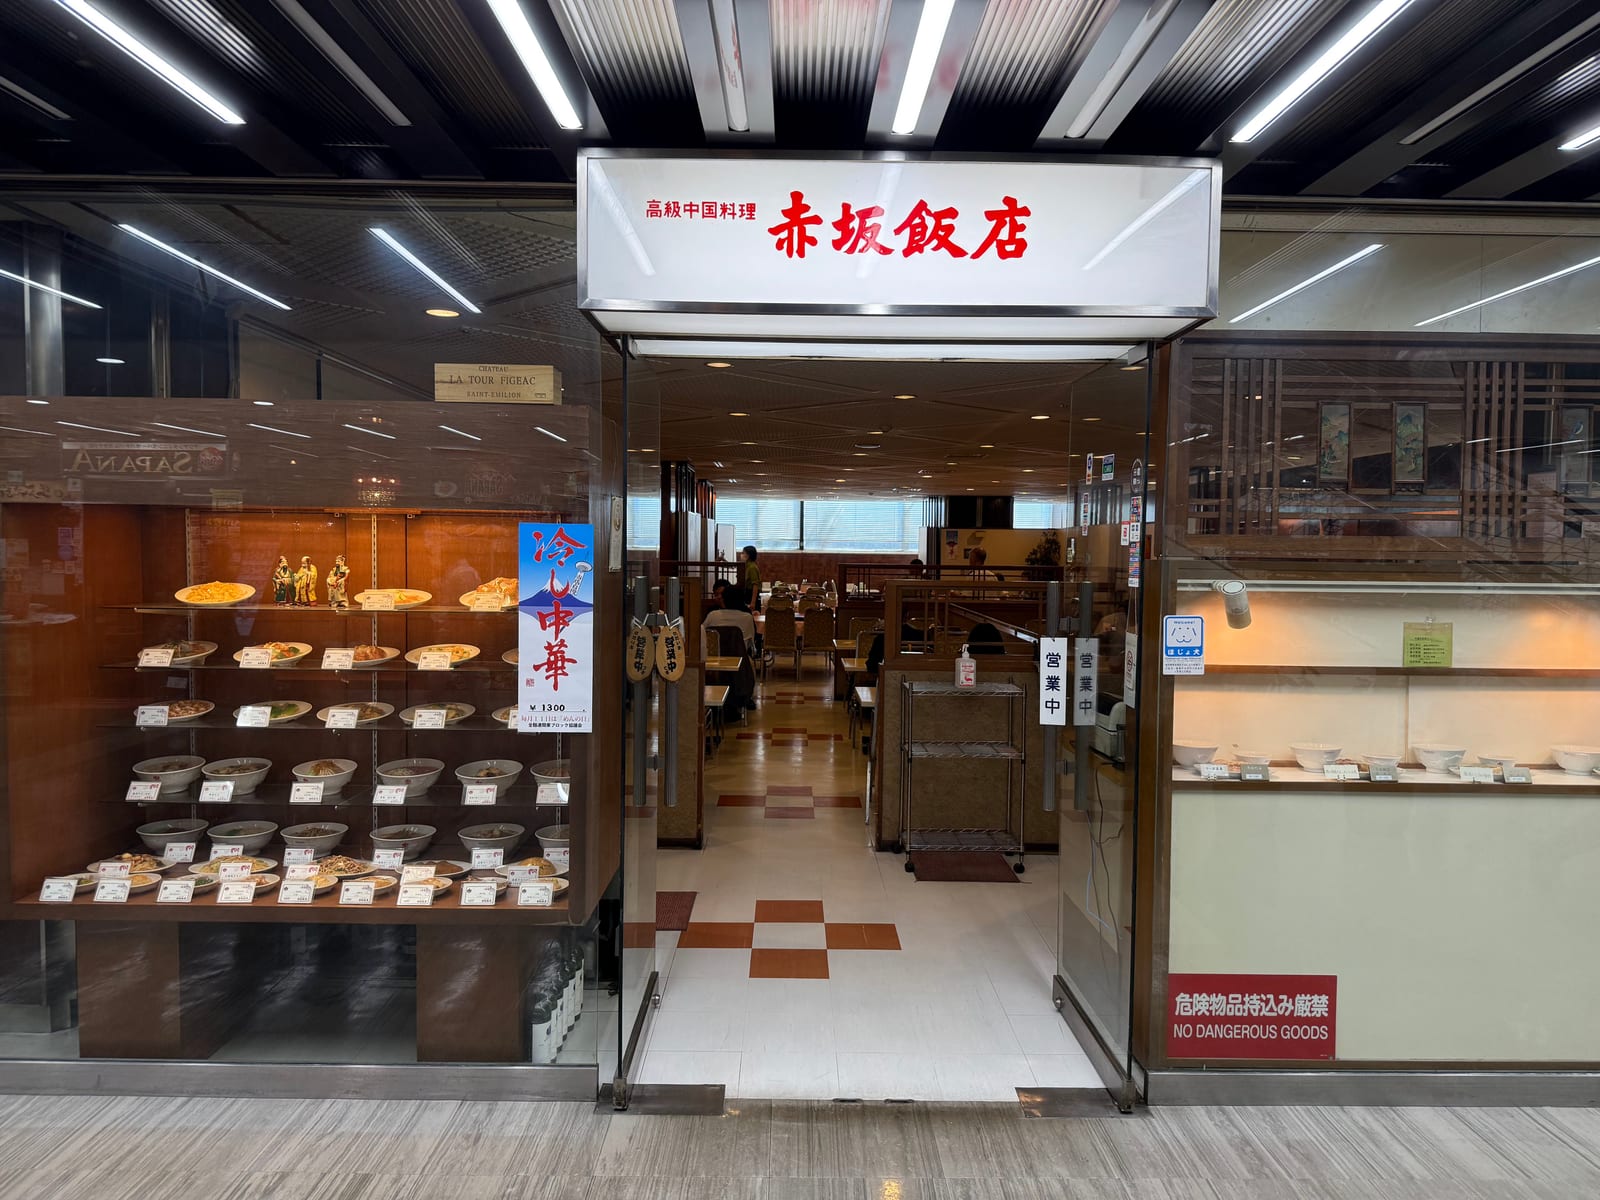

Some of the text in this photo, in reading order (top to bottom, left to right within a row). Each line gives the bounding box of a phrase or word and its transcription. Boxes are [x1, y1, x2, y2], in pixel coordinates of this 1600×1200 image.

[645, 199, 757, 221] 高級中国料理
[767, 190, 1032, 260] 赤坂飯店
[449, 375, 536, 386] LA TOUR FIGEAC
[532, 527, 588, 692] 冷し中華
[1167, 648, 1201, 656] ほじょ犬
[1044, 652, 1061, 715] 営業中
[542, 703, 566, 712] 1300
[1174, 992, 1329, 1018] 危険物品持込み厳禁
[1173, 1023, 1329, 1040] NO DANGEROUS GOODS
